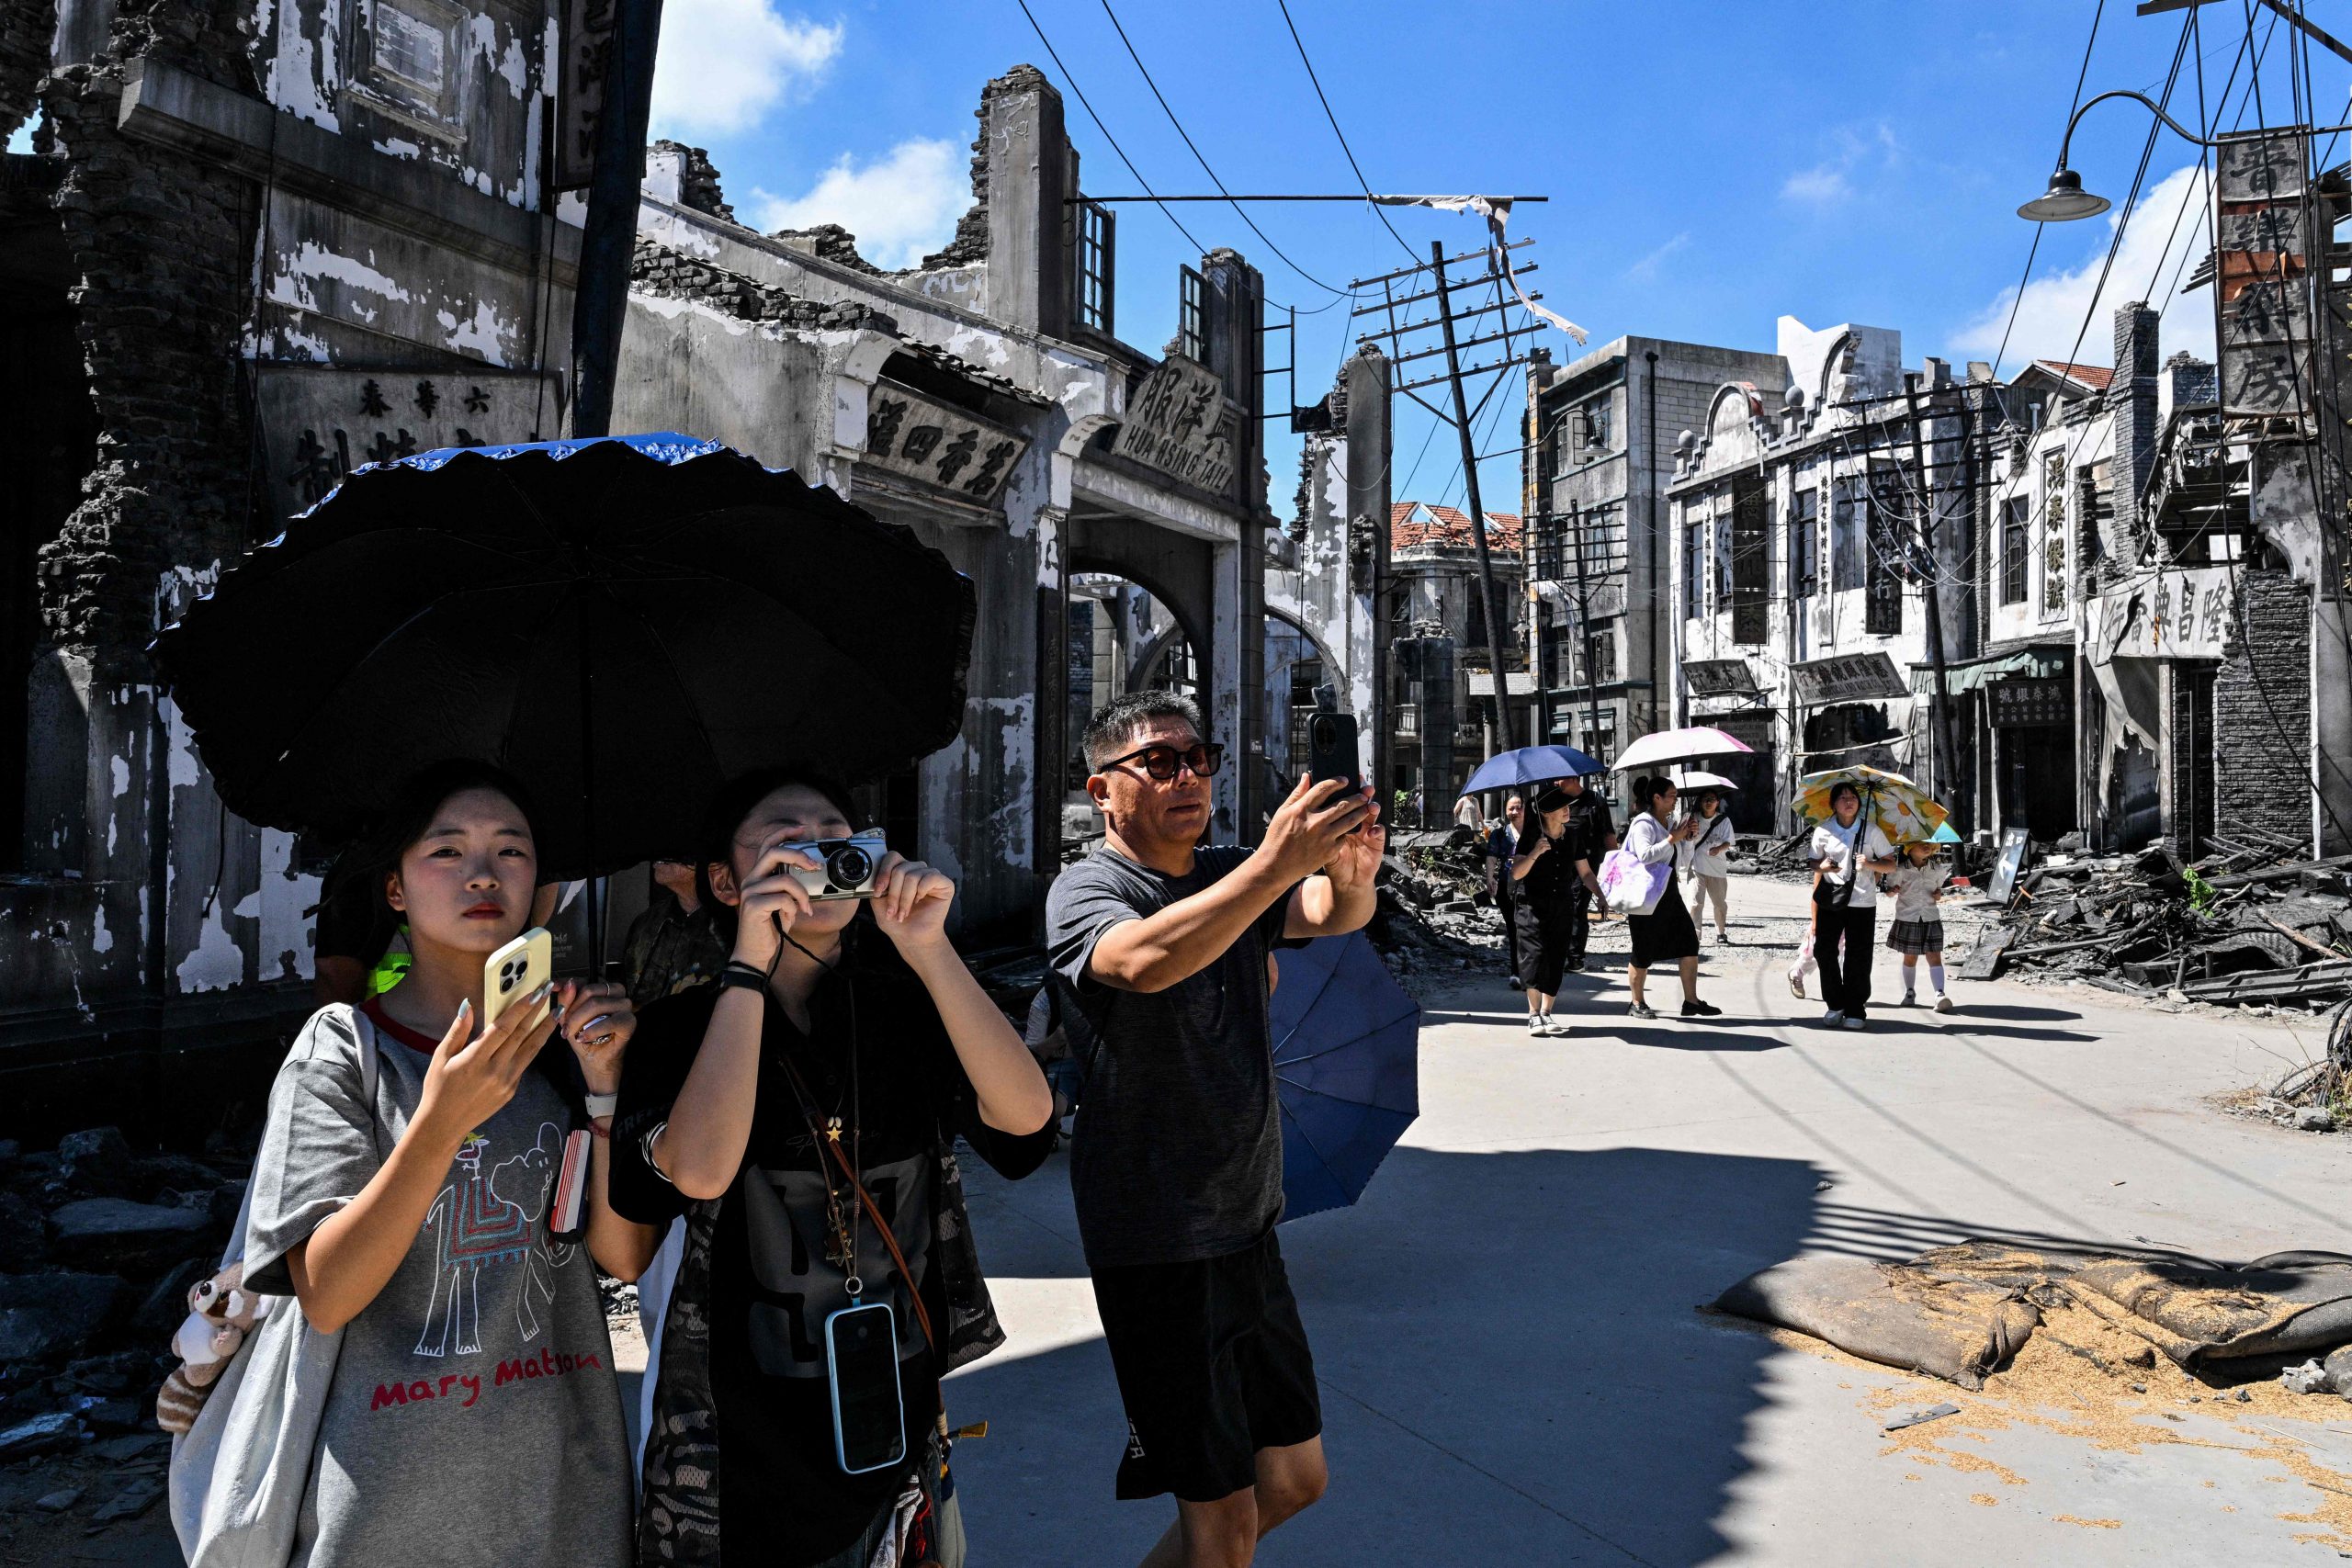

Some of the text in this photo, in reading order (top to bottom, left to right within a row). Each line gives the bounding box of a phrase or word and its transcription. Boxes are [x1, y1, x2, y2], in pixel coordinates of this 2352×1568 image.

[1124, 424, 1156, 459] HUA
[1155, 438, 1200, 477] HSING
[1998, 684, 2062, 705] 鴻泰銀號
[2005, 831, 2024, 847] 出口
[370, 1347, 603, 1411] Mary Matson
